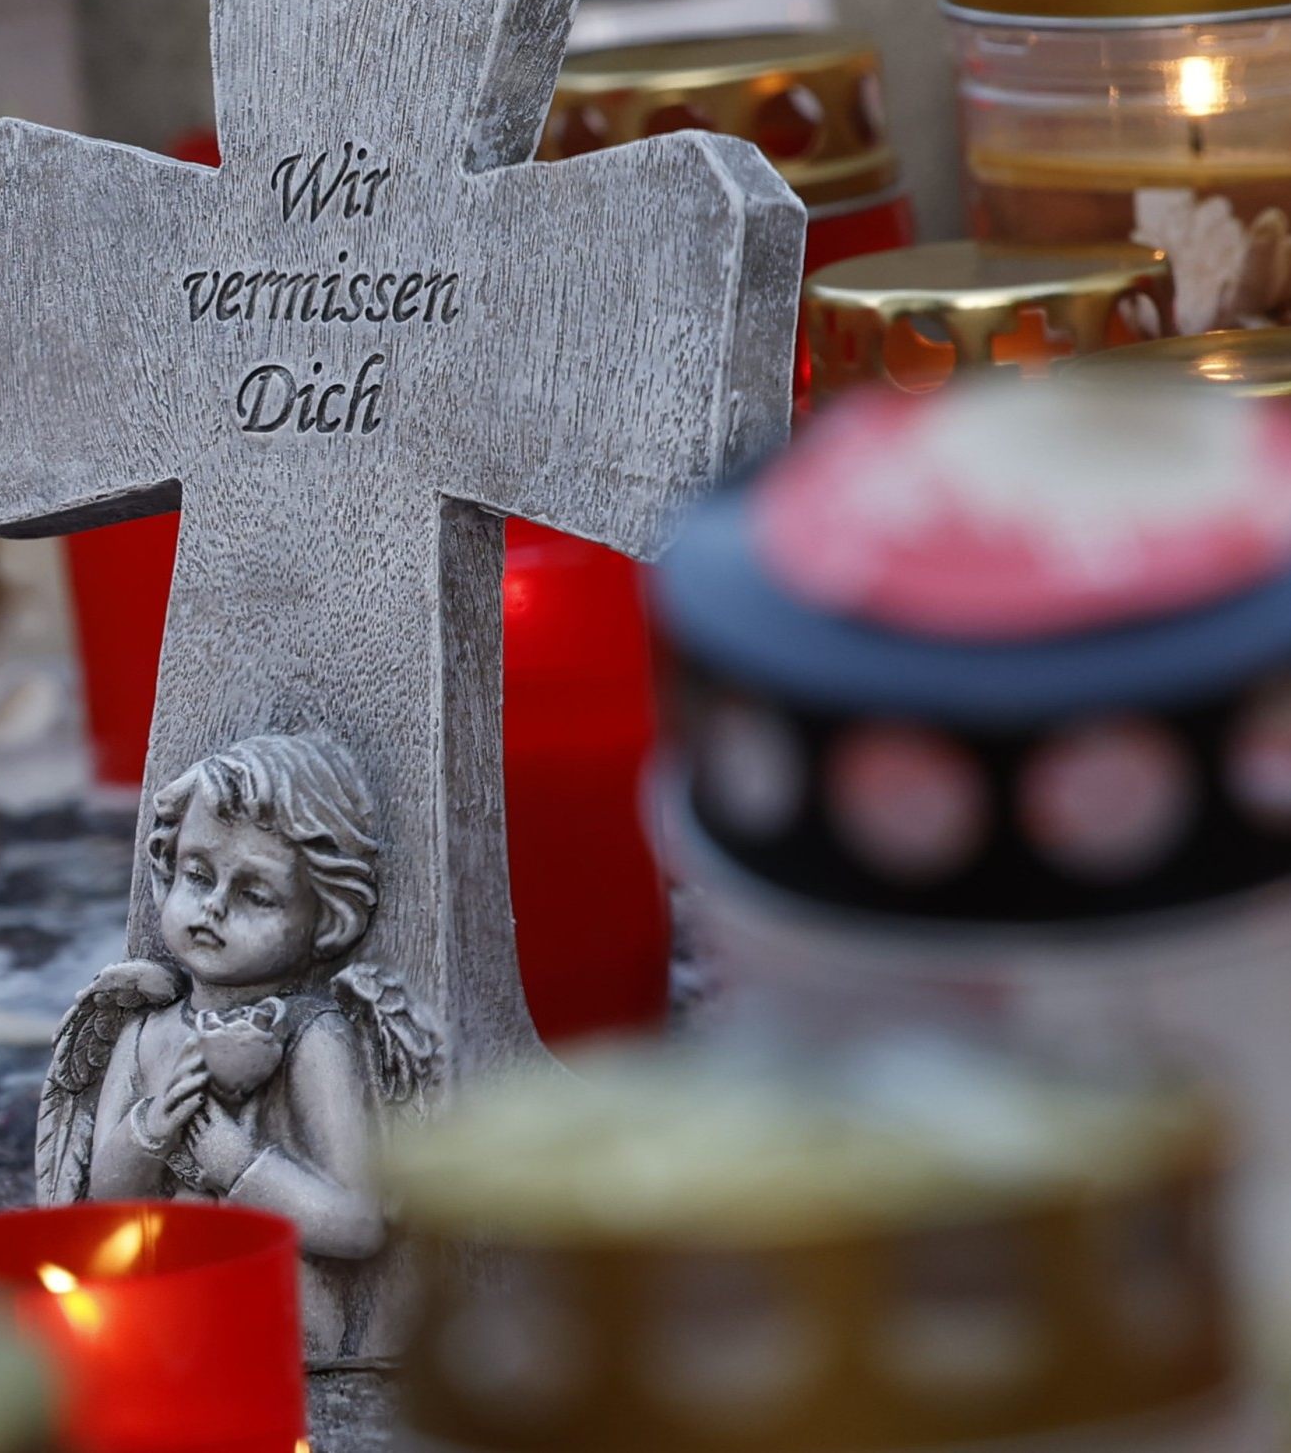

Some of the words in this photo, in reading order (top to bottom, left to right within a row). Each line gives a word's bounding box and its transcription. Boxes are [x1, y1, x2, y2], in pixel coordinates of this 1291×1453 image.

[271, 141, 391, 223] Wir
[182, 250, 460, 324] vermissen
[236, 352, 386, 435] Dich
